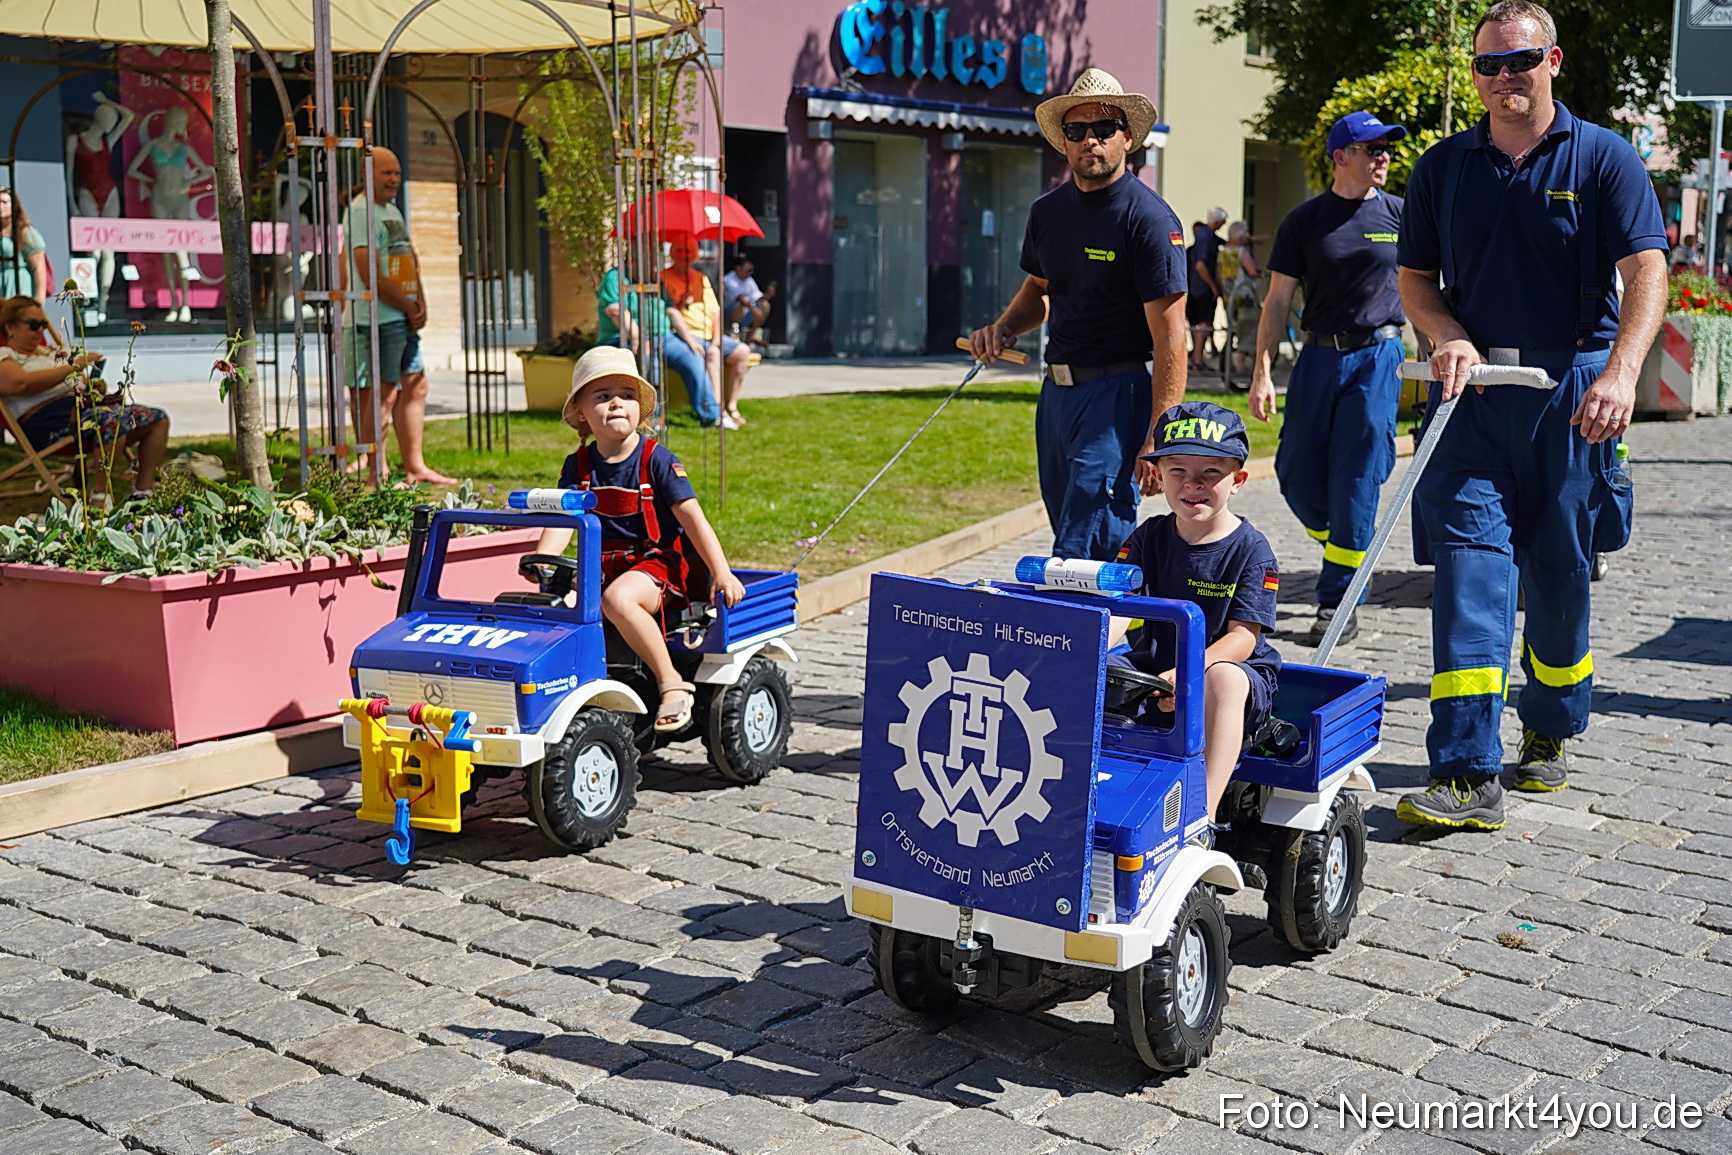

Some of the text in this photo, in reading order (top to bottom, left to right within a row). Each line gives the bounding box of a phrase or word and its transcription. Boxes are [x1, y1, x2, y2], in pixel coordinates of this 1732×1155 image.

[840, 0, 1007, 89] Eilles
[1163, 417, 1227, 443] THW
[1187, 578, 1231, 591] Technische
[402, 624, 529, 649] THW
[892, 604, 1072, 652] Technisches Hilfswerk
[881, 811, 1055, 888] Ortsverband Neumarkt
